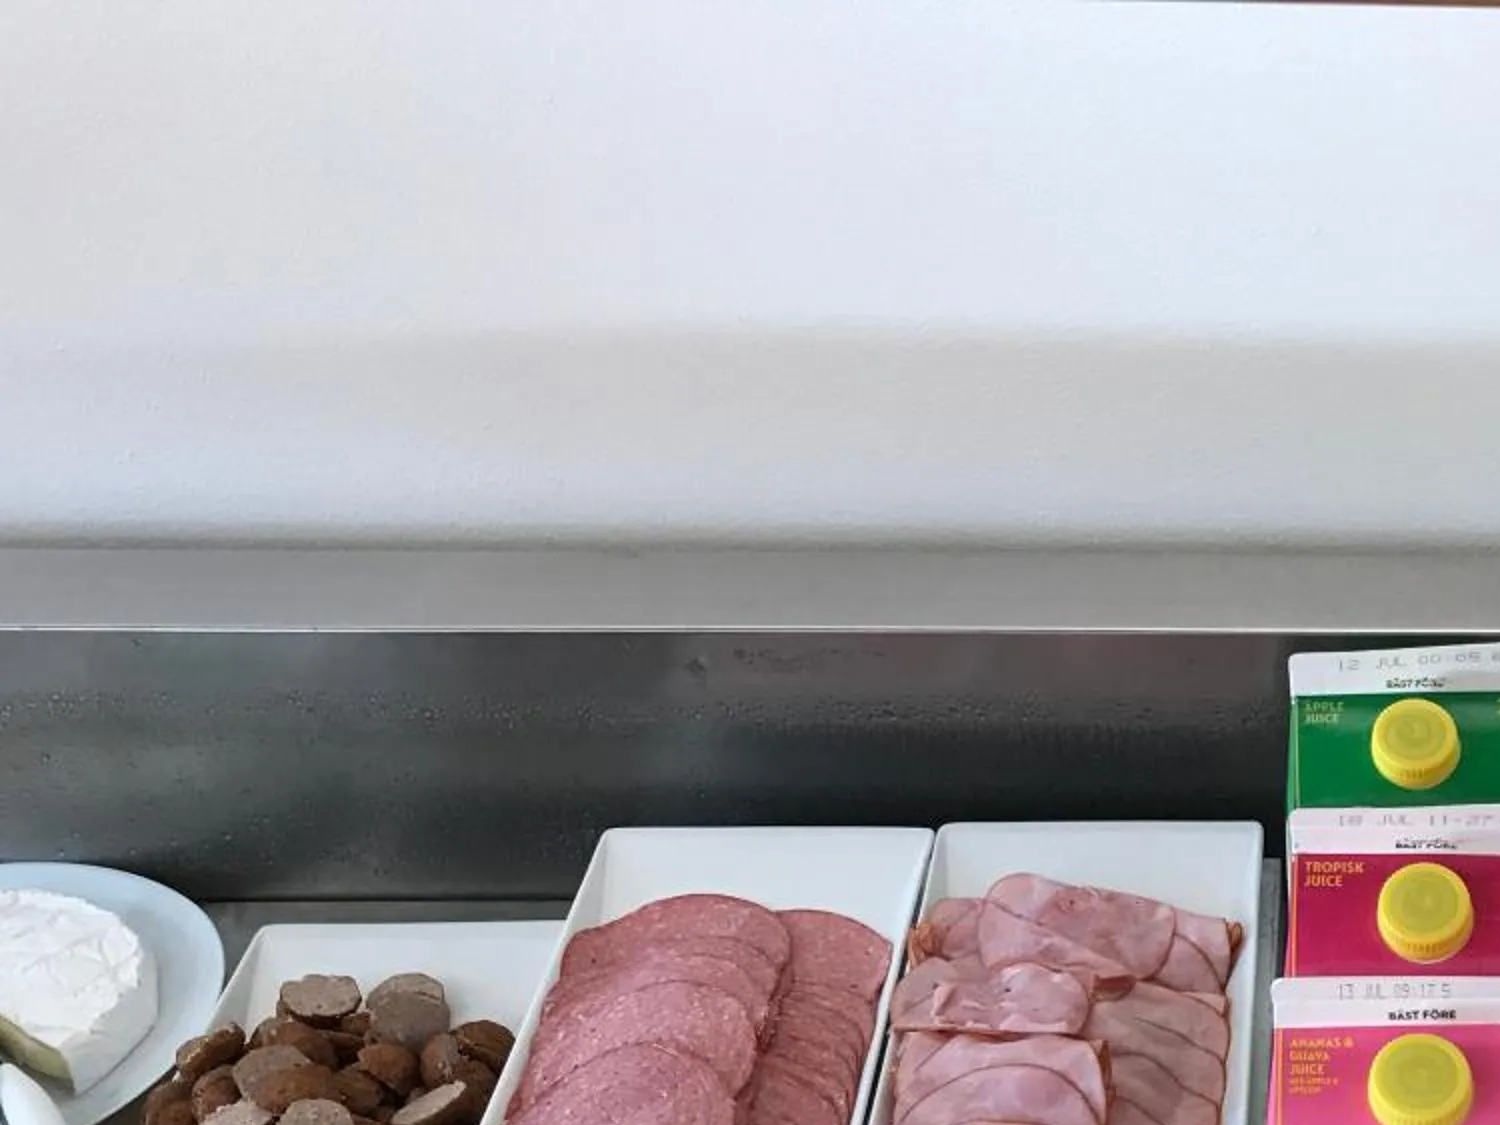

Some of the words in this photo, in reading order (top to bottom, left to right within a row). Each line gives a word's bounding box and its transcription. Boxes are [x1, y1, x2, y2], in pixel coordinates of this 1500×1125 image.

[1304, 861, 1365, 874] TROPISK
[1304, 875, 1343, 887] JUICE
[1388, 1010, 1420, 1021] BÄST
[1423, 1008, 1457, 1020] FÖRE
[1289, 1063, 1326, 1075] JUICE
